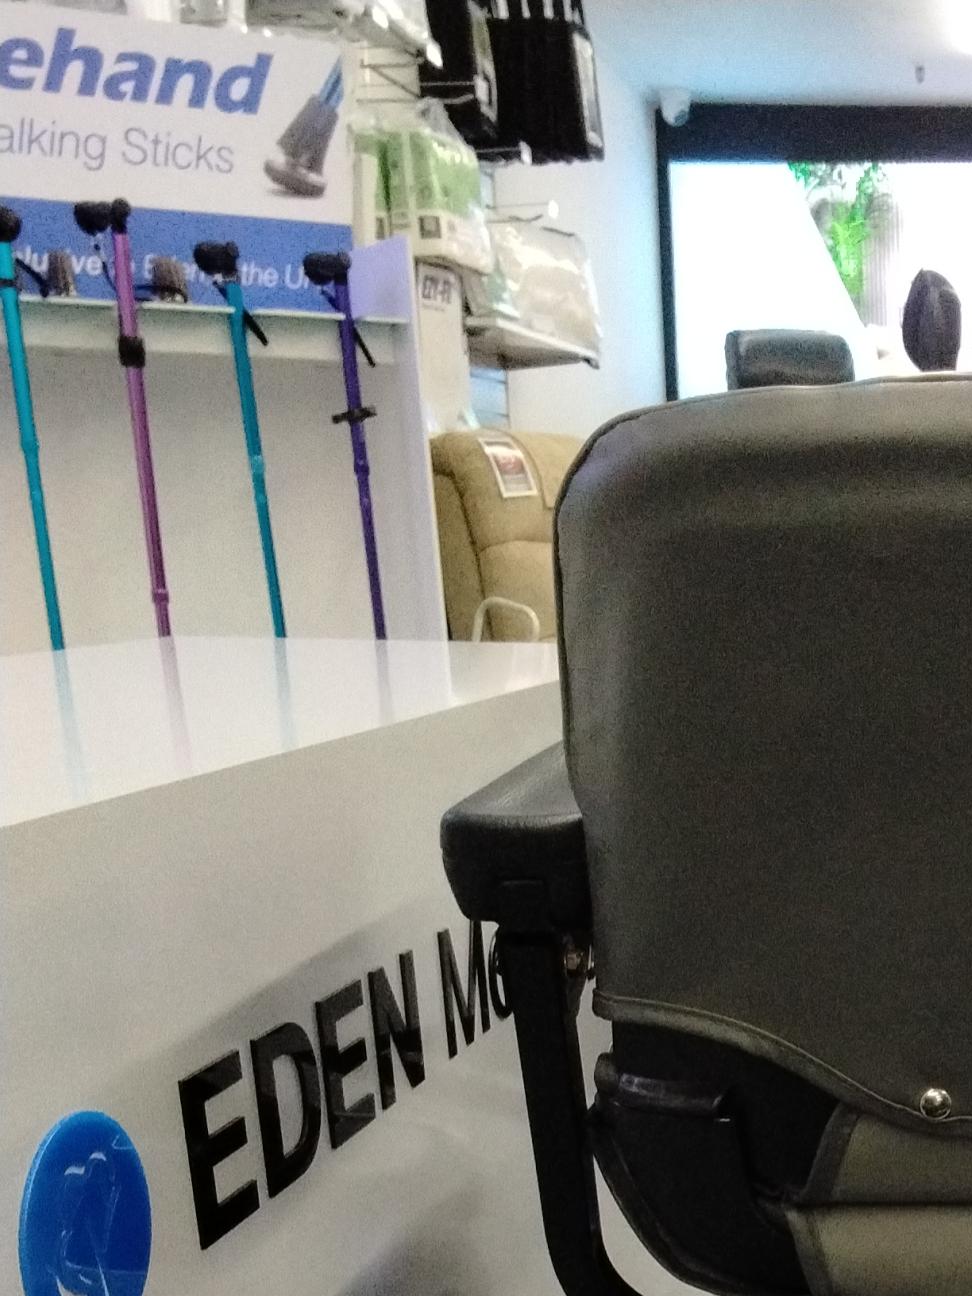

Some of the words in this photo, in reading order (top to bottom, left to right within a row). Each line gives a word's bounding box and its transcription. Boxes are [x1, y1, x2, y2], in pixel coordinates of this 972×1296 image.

[121, 127, 235, 174] Sticks
[241, 261, 279, 288] the
[178, 949, 426, 1251] EDEN
